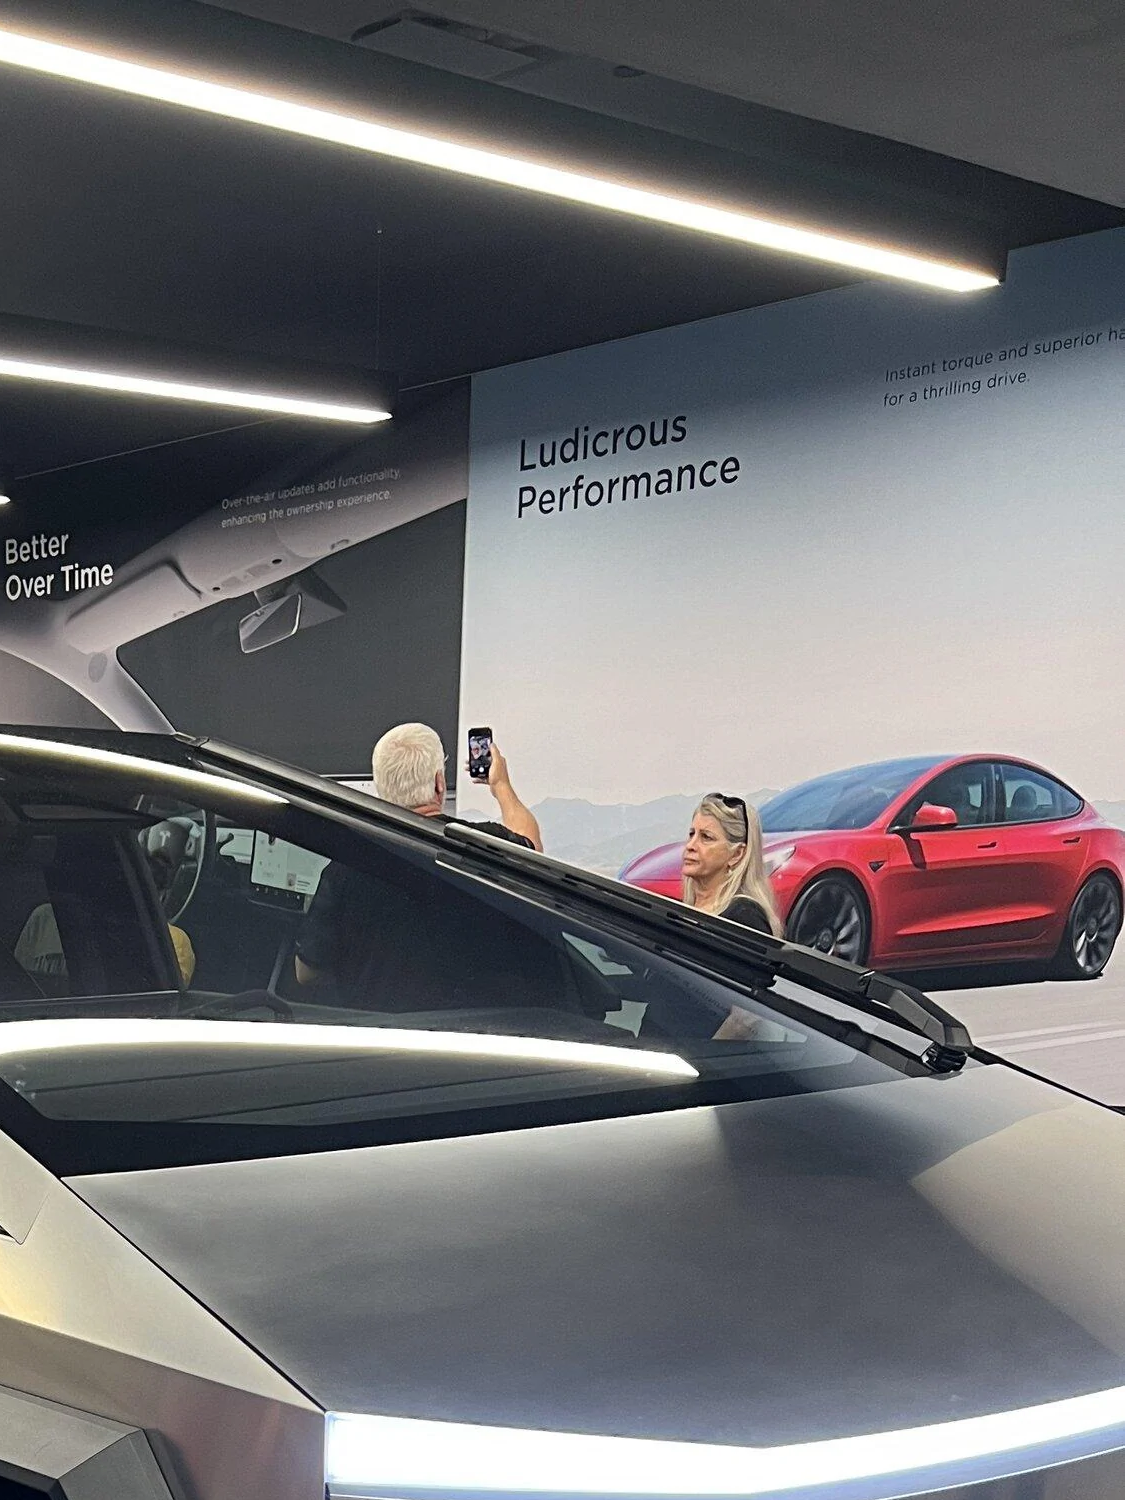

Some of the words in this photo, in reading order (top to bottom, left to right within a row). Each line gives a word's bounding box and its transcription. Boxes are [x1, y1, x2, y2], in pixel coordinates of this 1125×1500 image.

[885, 362, 937, 382] Instant
[942, 352, 993, 372] torque
[998, 343, 1029, 362] and
[1033, 331, 1103, 356] superior
[883, 392, 904, 407] for
[909, 391, 918, 403] a
[923, 379, 981, 401] thrilling
[987, 370, 1030, 389] drive.
[519, 415, 688, 472] Ludicrous
[277, 484, 316, 500] updates
[317, 477, 336, 492] add
[517, 456, 741, 519] Performance
[221, 512, 267, 528] enhancing
[269, 508, 284, 520] the
[286, 501, 335, 517] ownership
[5, 533, 70, 565] Better
[5, 573, 55, 601] Over
[60, 563, 114, 592] Time
